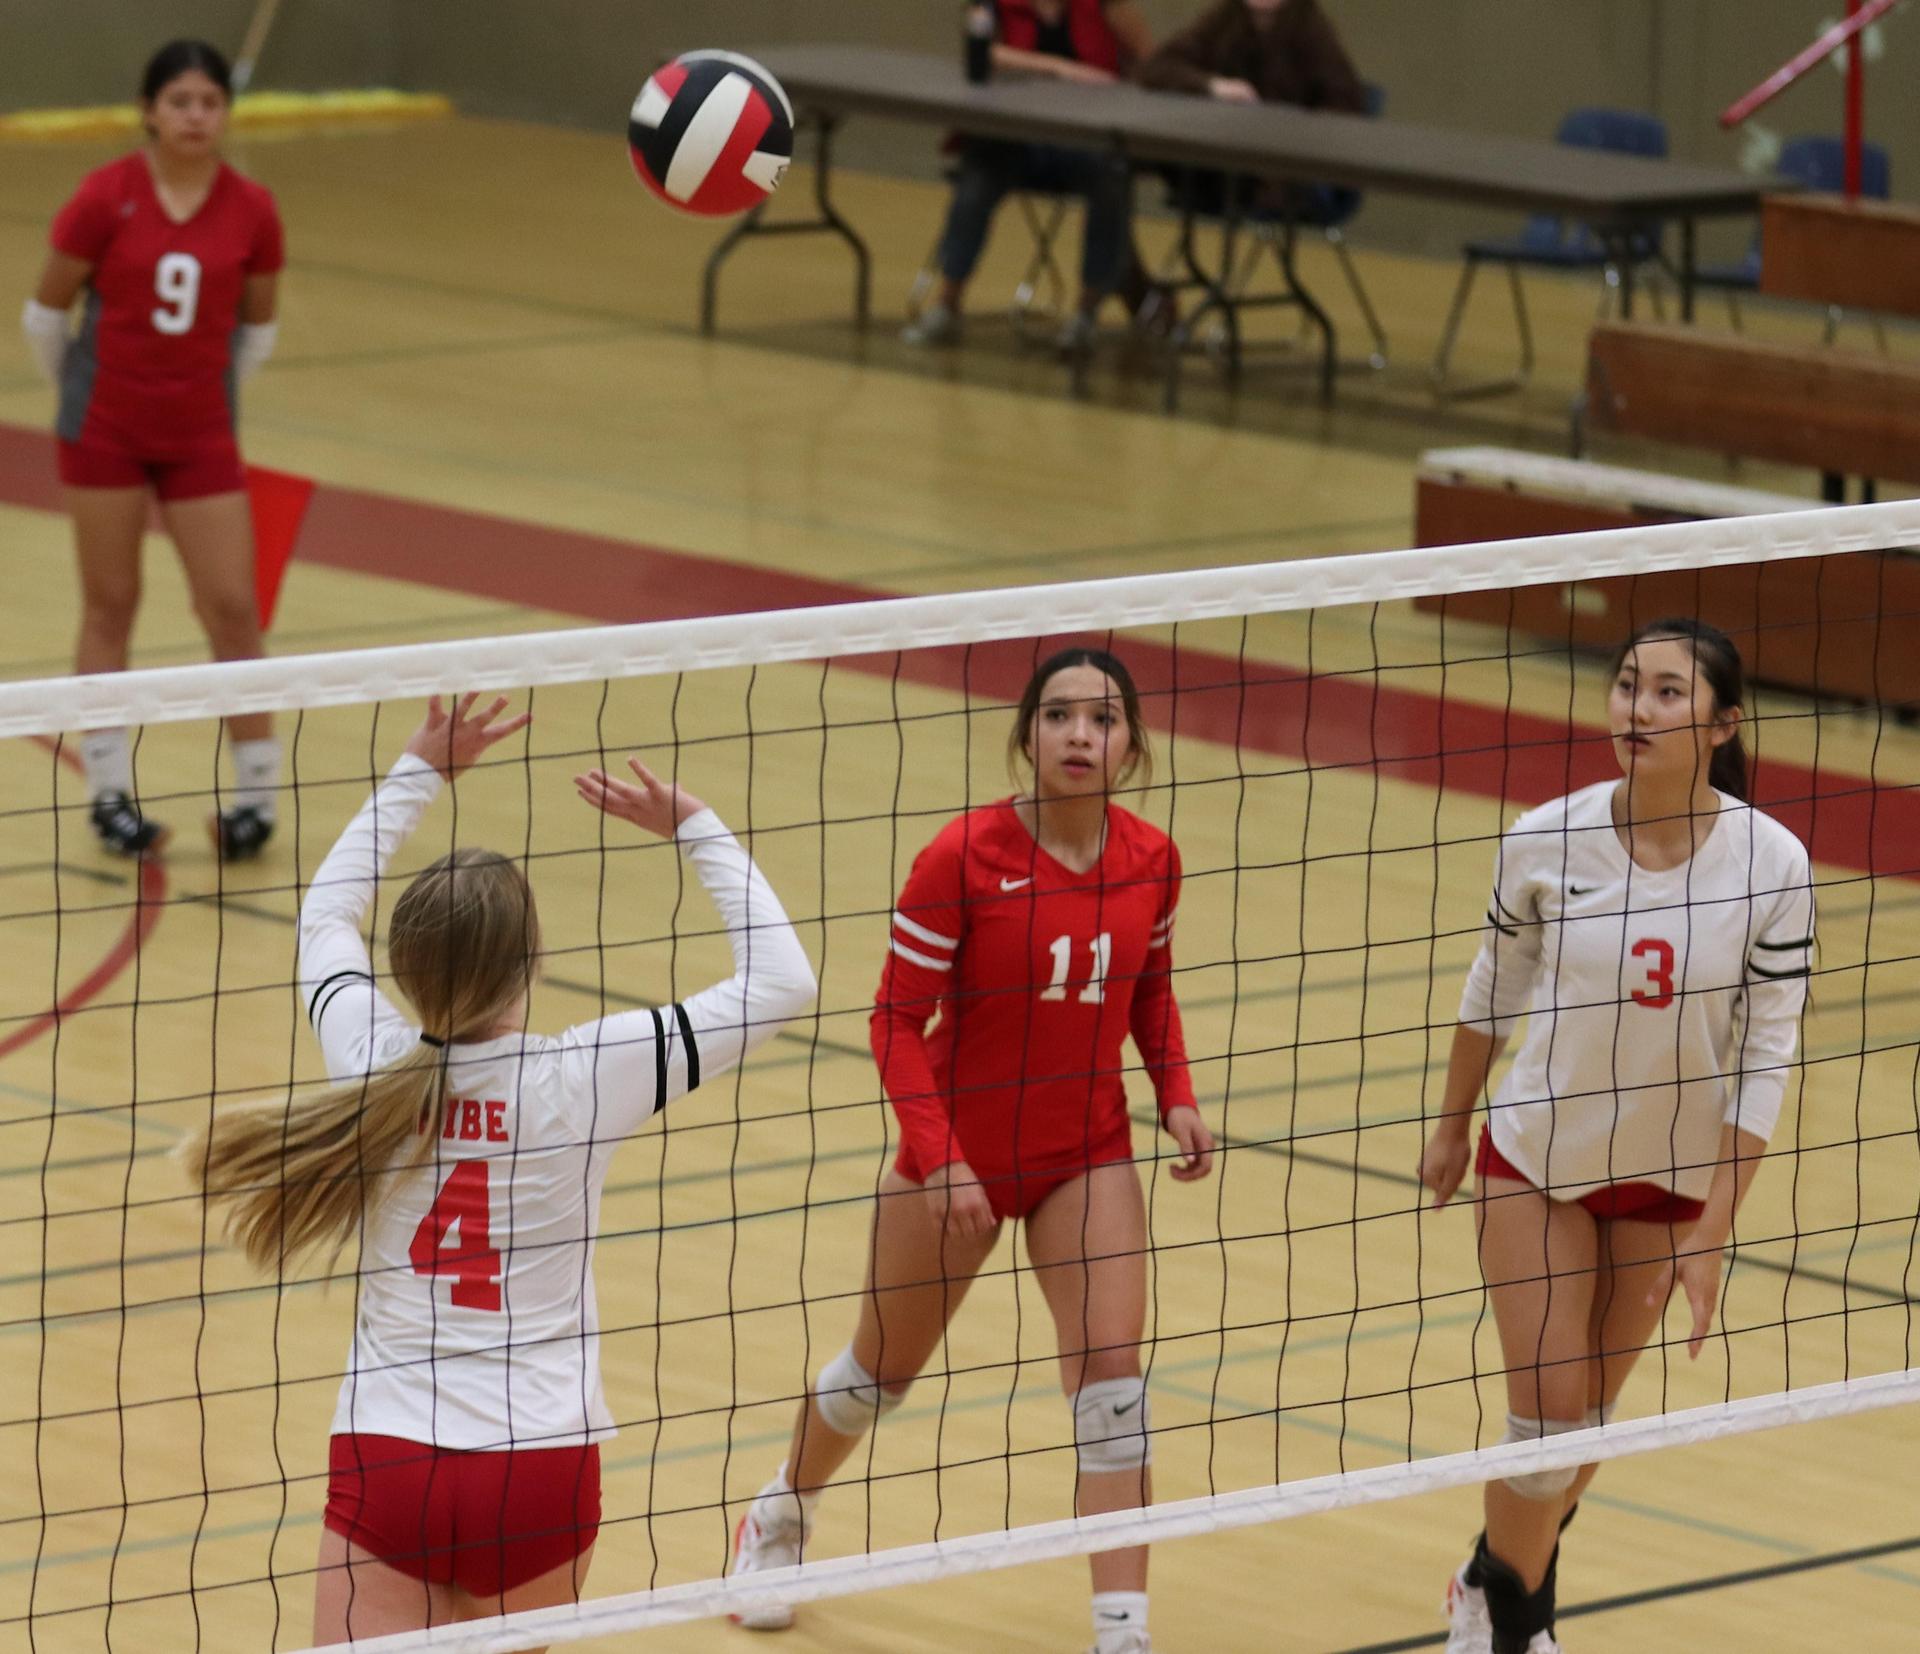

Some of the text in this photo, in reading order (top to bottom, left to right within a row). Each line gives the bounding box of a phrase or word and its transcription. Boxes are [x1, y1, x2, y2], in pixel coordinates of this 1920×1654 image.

[152, 252, 202, 335] 9
[1039, 932, 1112, 1006] 11
[1631, 938, 1674, 1009] 3
[408, 1159, 502, 1312] 4
